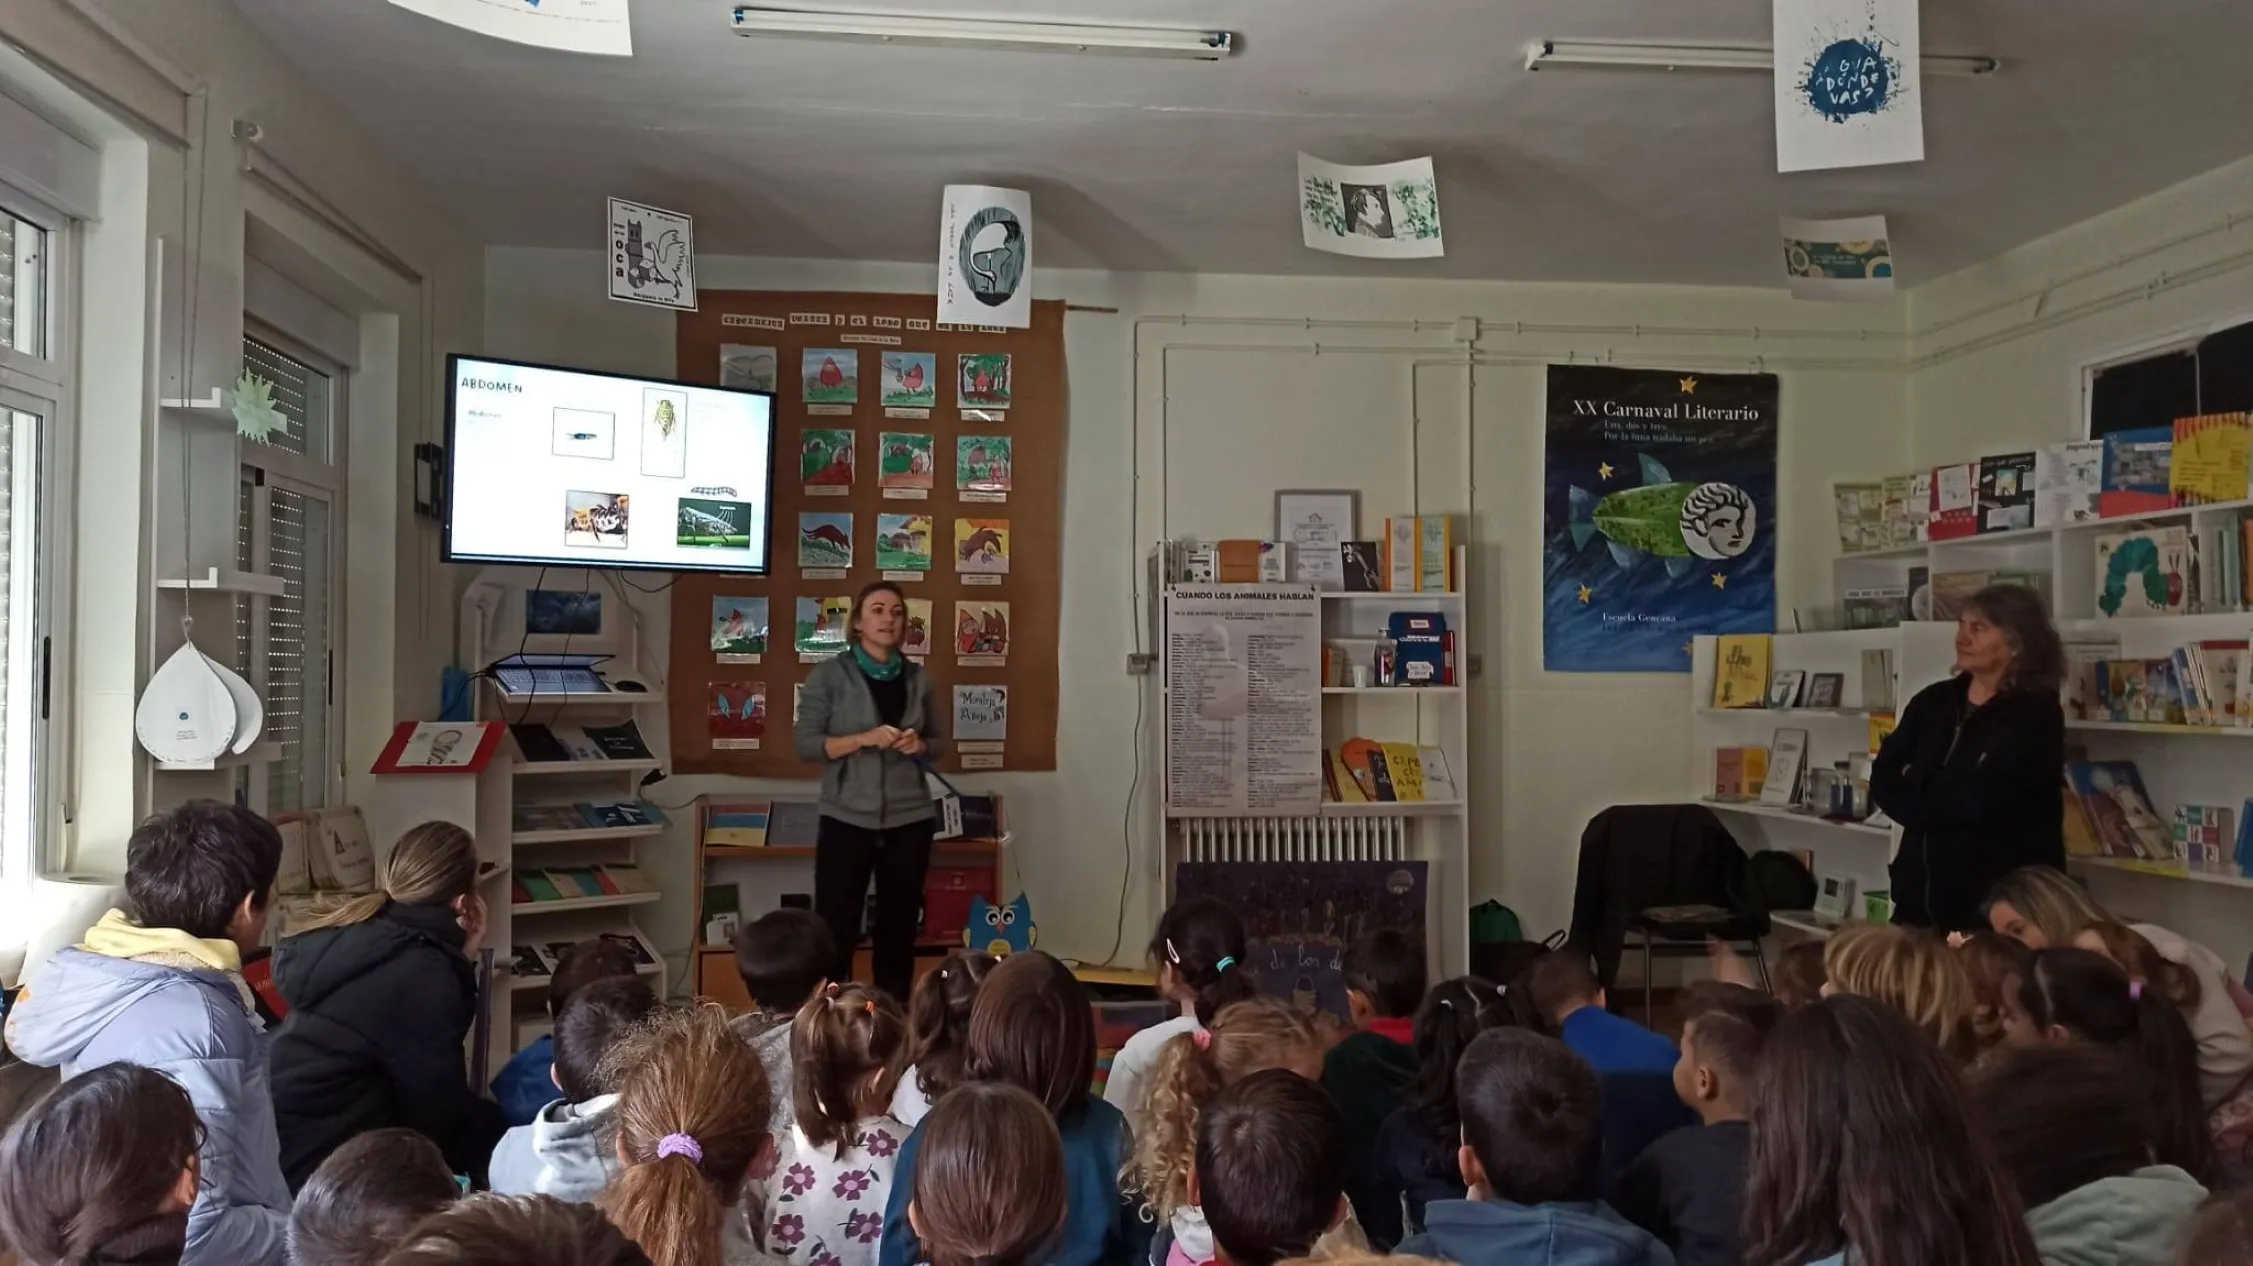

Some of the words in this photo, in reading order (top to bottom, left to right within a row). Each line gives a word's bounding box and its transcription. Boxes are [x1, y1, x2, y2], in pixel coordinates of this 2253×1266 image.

[461, 376, 523, 394] ABDOMEN
[1572, 399, 1598, 416] XX
[1603, 400, 1679, 419] Carnaval
[1685, 403, 1760, 421] Literario
[1176, 591, 1213, 600] CUANDO
[1215, 592, 1232, 600] LOS
[1234, 592, 1277, 601] ANIMALES
[1279, 593, 1315, 602] HABLAN
